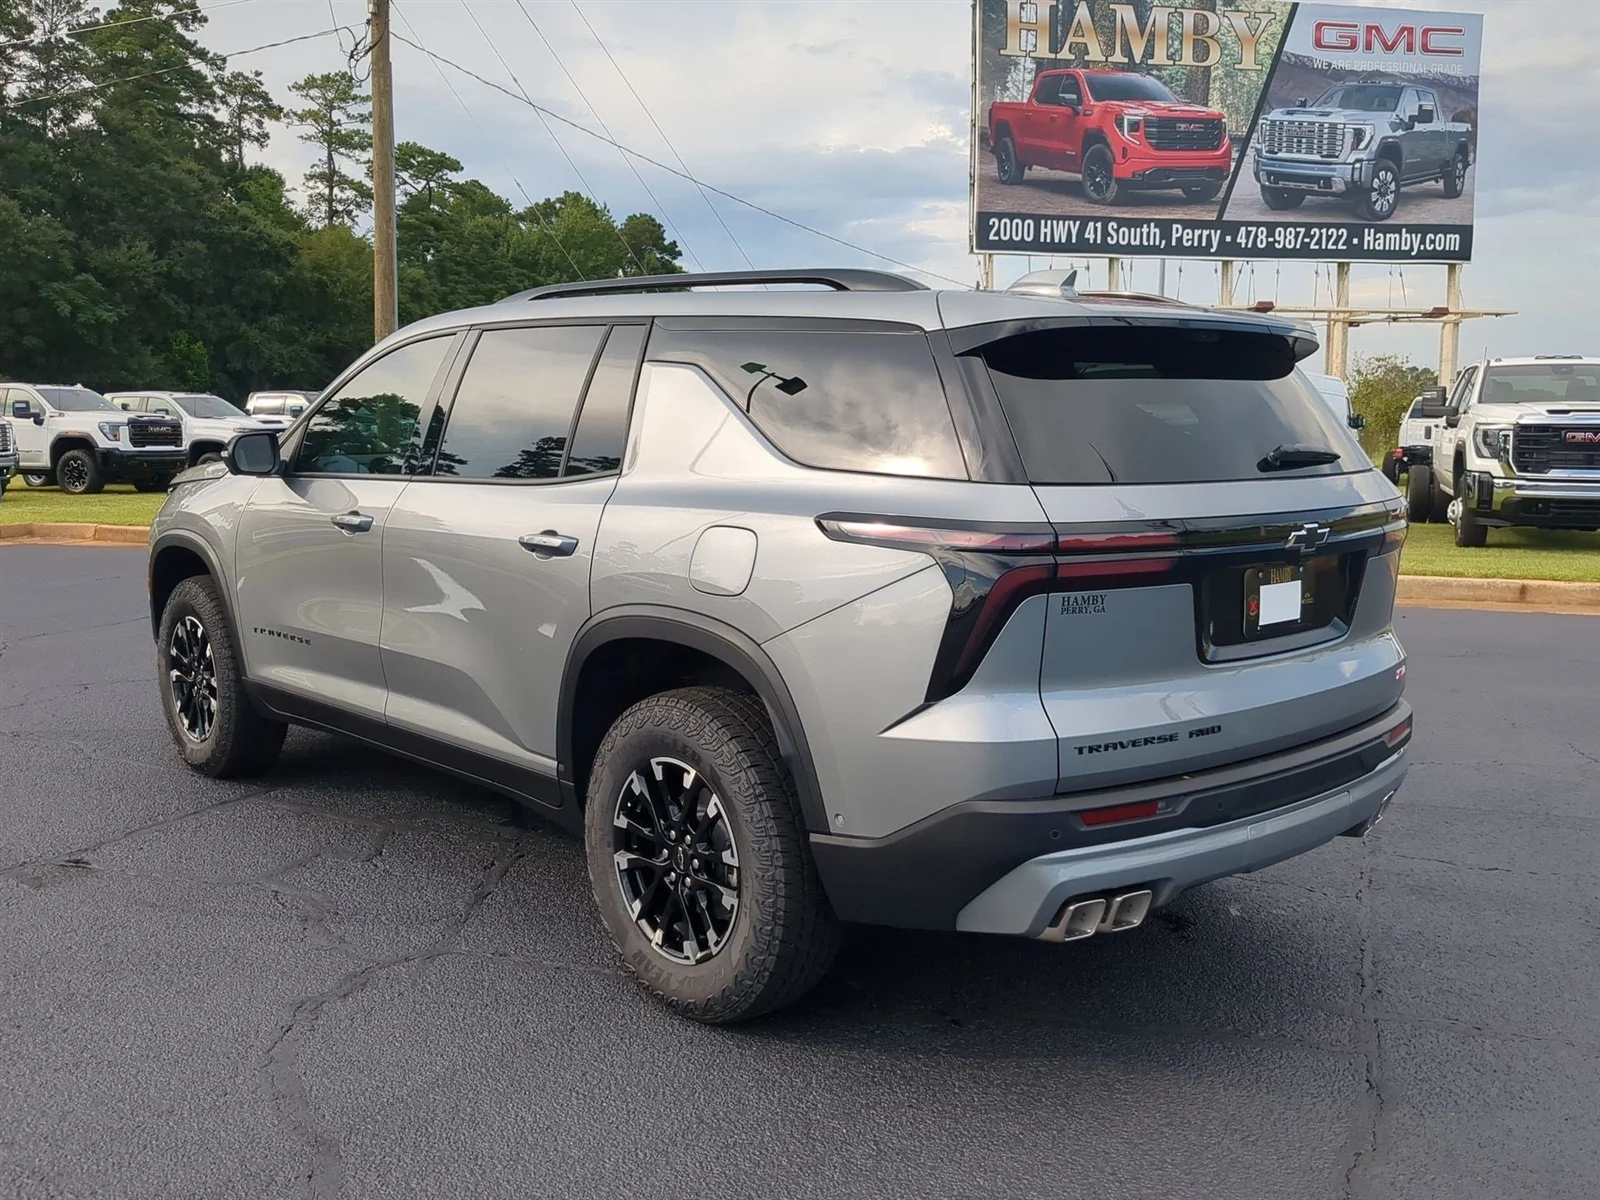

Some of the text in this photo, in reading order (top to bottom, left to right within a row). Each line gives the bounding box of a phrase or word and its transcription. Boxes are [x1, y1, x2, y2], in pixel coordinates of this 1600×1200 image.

[1000, 0, 1276, 71] HAMBY
[1312, 19, 1465, 57] GMC
[1313, 59, 1463, 74] WE ARE PROFESSIONAL GRADE
[988, 217, 1461, 255] 2000 HWY 41 South, Perry 478-987-2122 Hamby.com
[1566, 432, 1600, 443] GM
[1270, 565, 1295, 584] HAMBY
[1060, 604, 1106, 616] PERRY, GA
[1061, 594, 1107, 607] HAMBY
[253, 627, 312, 646] TRAVERSE
[1073, 725, 1222, 755] TRAVERSE AWD
